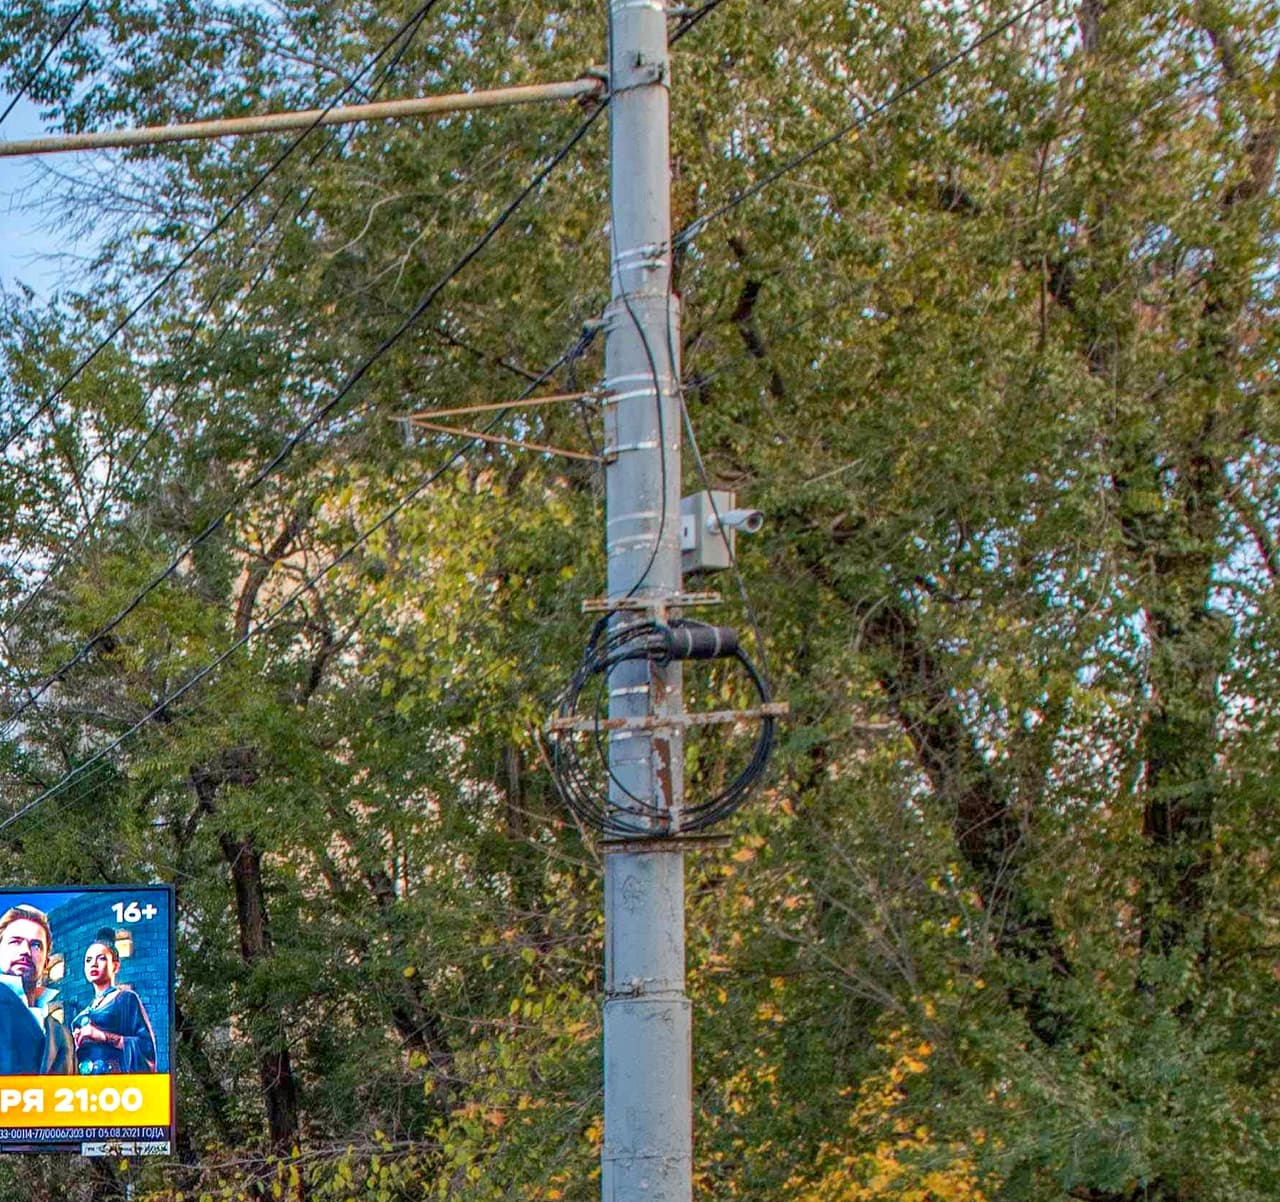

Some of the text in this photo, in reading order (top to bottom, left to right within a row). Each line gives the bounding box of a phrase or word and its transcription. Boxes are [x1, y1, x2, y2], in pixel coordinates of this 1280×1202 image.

[111, 901, 158, 923] 16+
[53, 1086, 144, 1113] 21:00
[85, 1127, 96, 1138] ОТ
[141, 1126, 164, 1138] ГОДА
